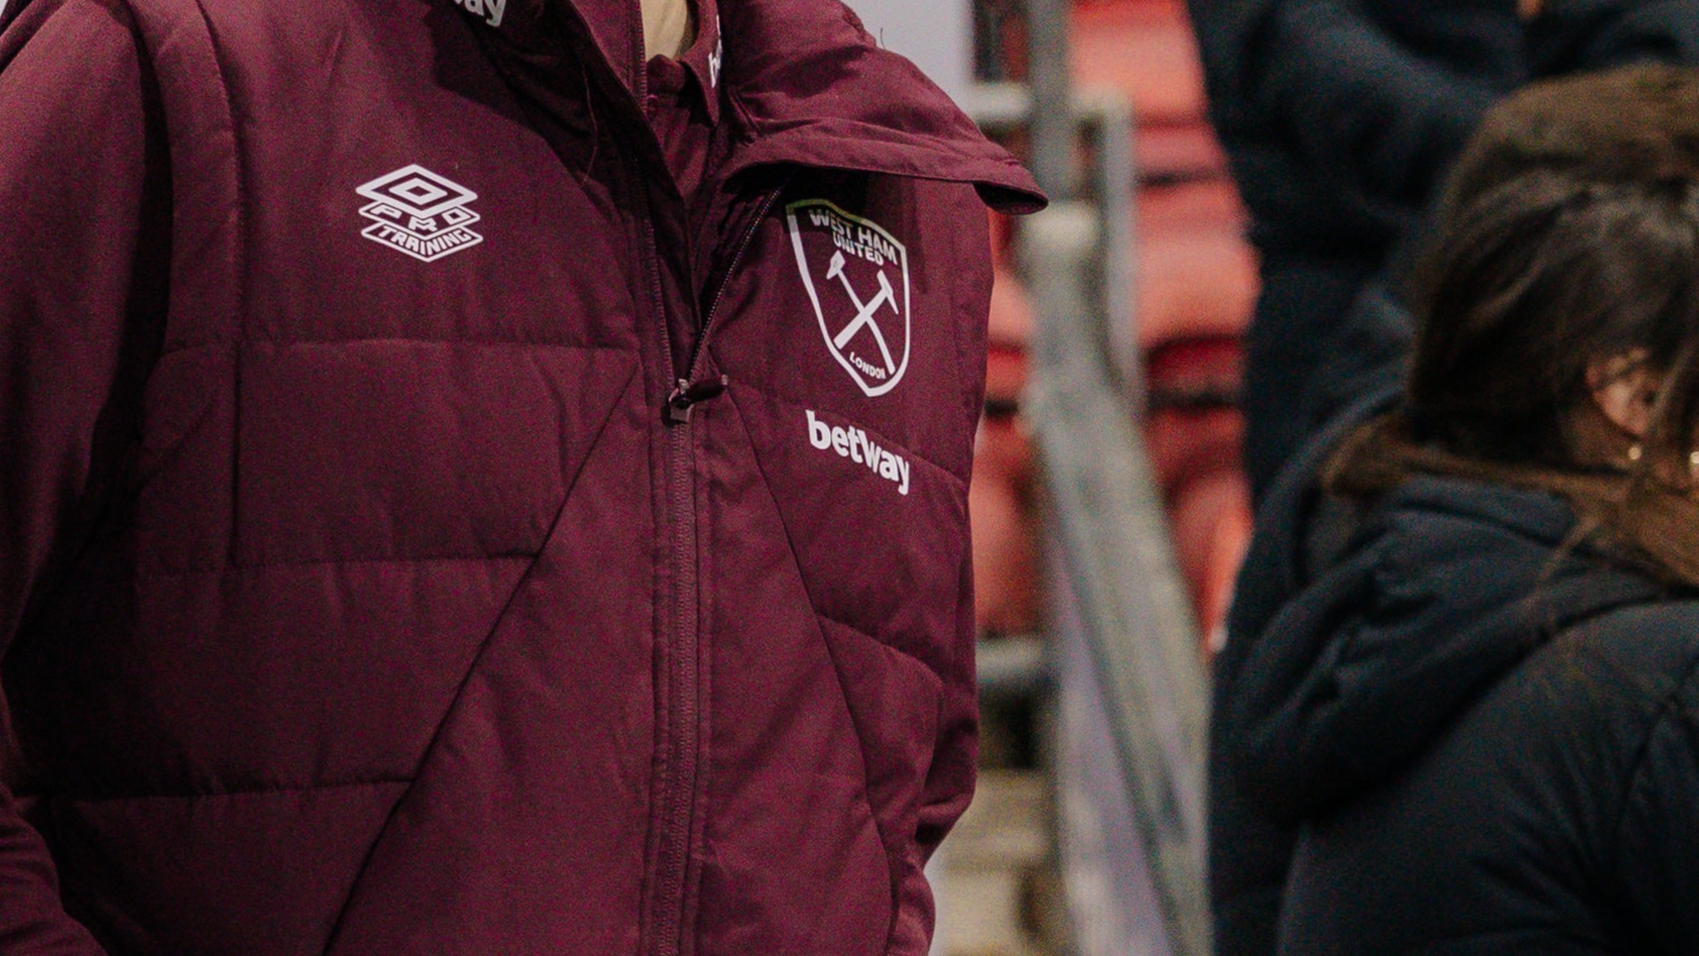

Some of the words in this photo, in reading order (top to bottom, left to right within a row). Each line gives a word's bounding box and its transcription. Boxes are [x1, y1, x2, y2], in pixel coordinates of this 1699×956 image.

[370, 202, 472, 232] PRO
[379, 225, 472, 256] TRAINING
[808, 209, 853, 240] WEST
[857, 227, 898, 266] HAM
[833, 231, 884, 266] UNITED
[850, 351, 886, 379] LONDON
[805, 409, 910, 495] betway
